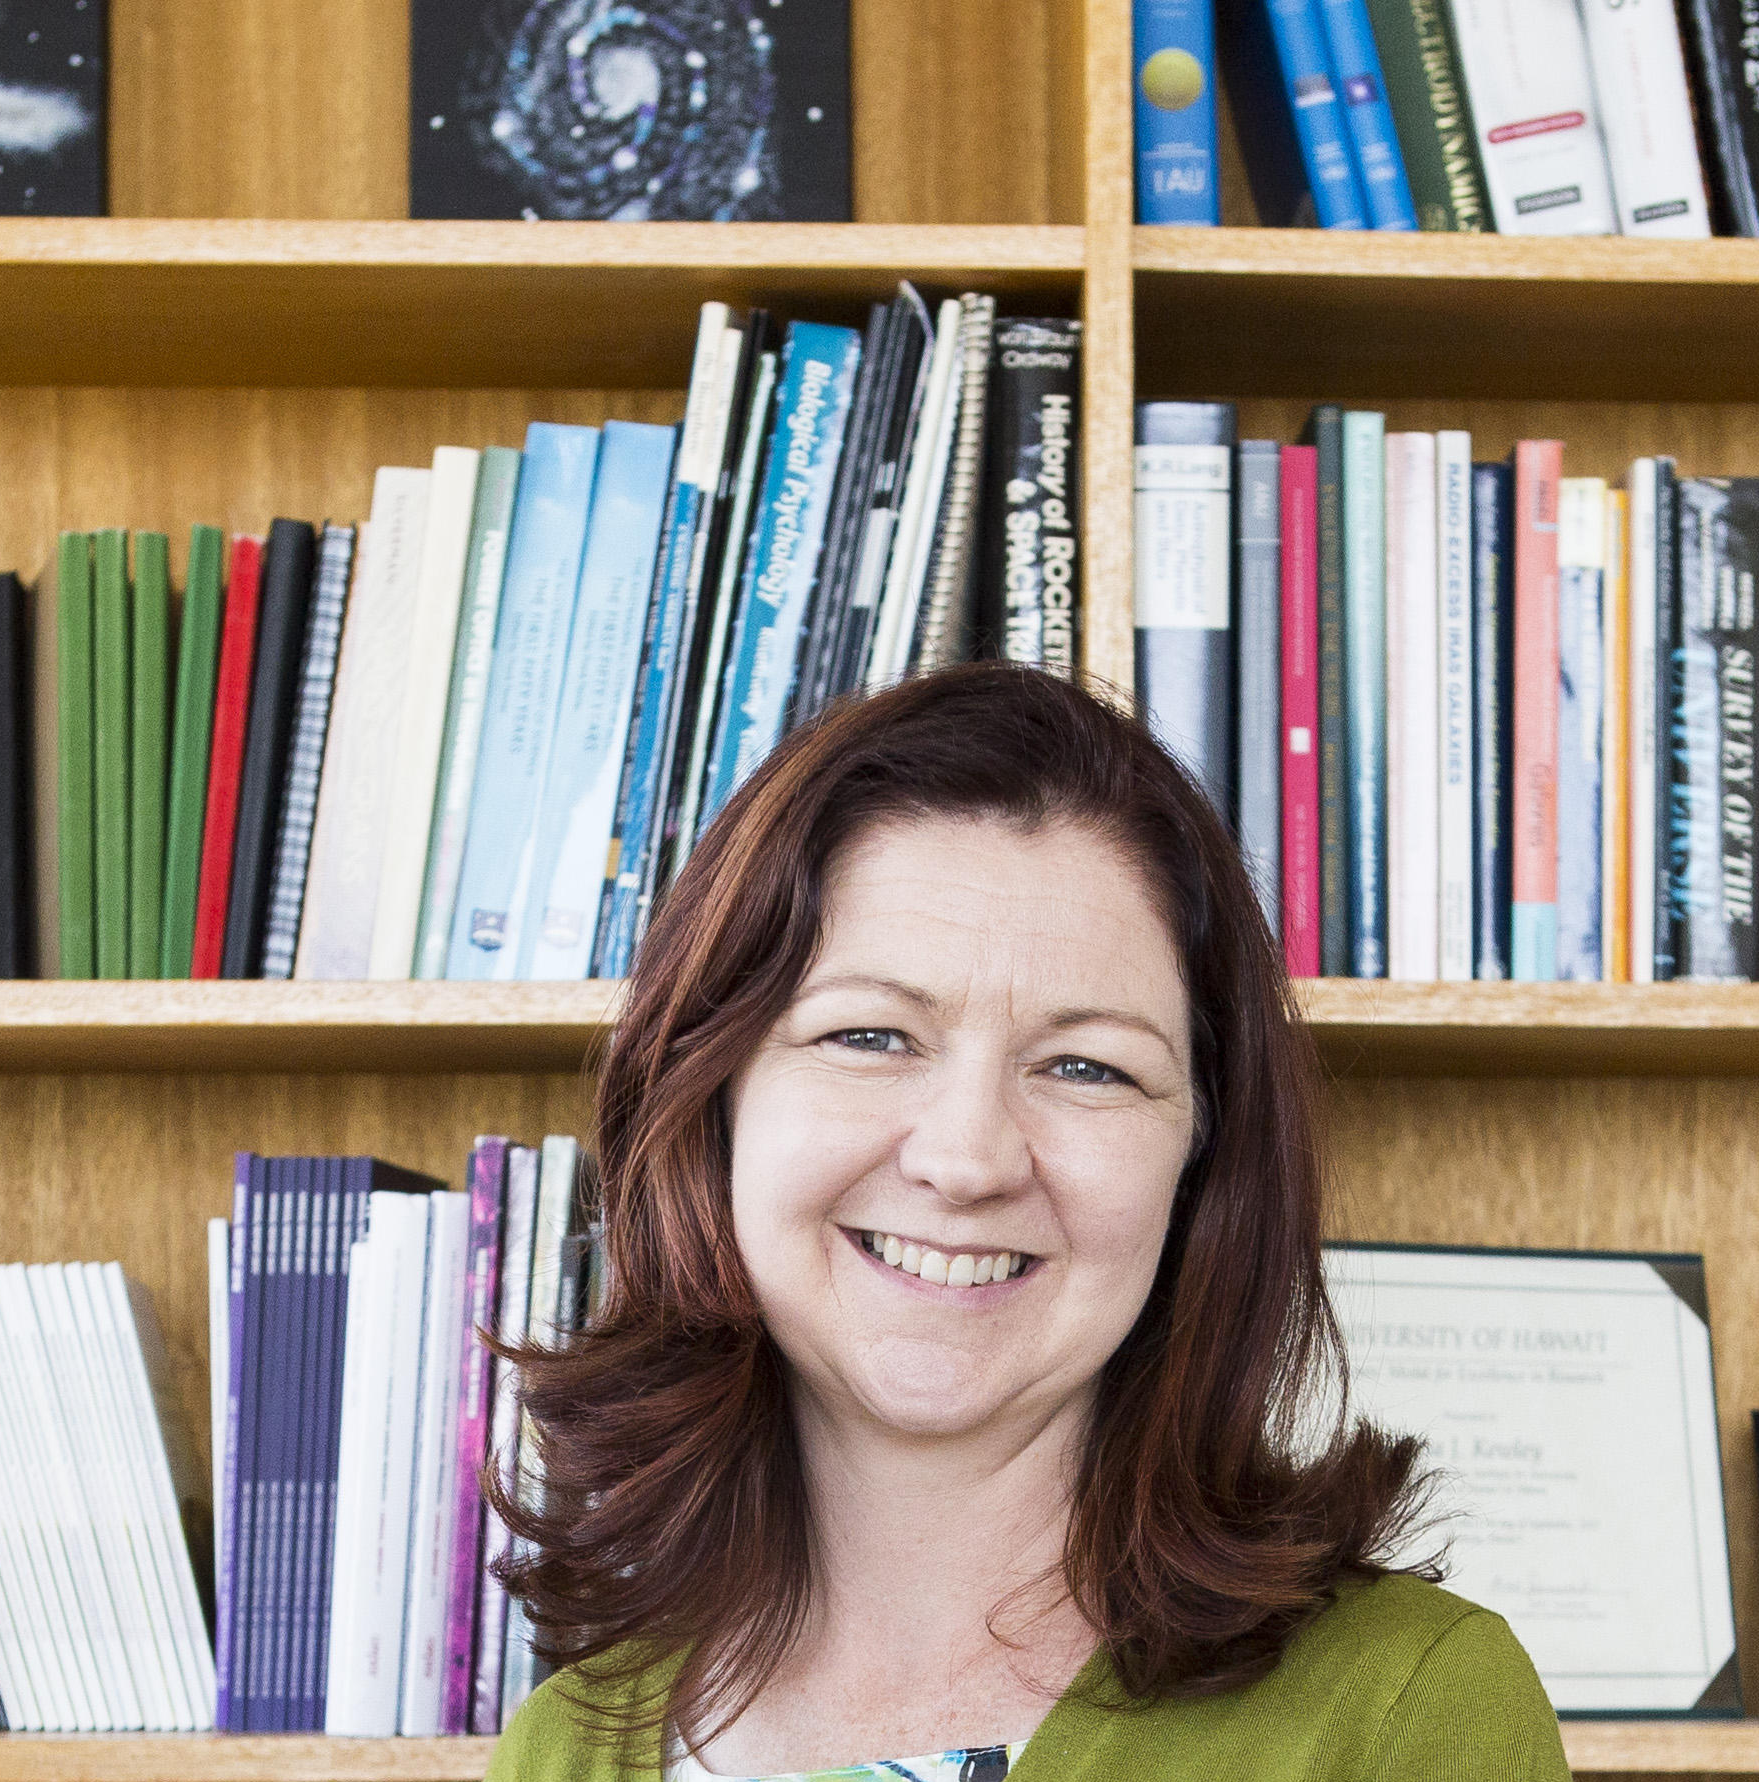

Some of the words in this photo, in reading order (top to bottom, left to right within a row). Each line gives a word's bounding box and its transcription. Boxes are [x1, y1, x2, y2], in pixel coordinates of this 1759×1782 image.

[784, 358, 833, 477] Biological
[1037, 394, 1071, 497] History
[1006, 479, 1037, 504] &
[1041, 498, 1073, 529] of
[756, 472, 810, 610] Psychology
[1006, 511, 1040, 607] SPACE
[531, 576, 550, 607] THE
[522, 610, 545, 655] FIRST
[1447, 626, 1463, 674] IRAS
[506, 702, 531, 755] YEARS
[1447, 681, 1463, 785] GALAXIES
[1722, 645, 1754, 790] SURVEY
[1671, 646, 1718, 924] UNIVERSE
[1722, 792, 1754, 848] OF
[1721, 851, 1753, 927] THE
[1472, 1326, 1508, 1350] OF
